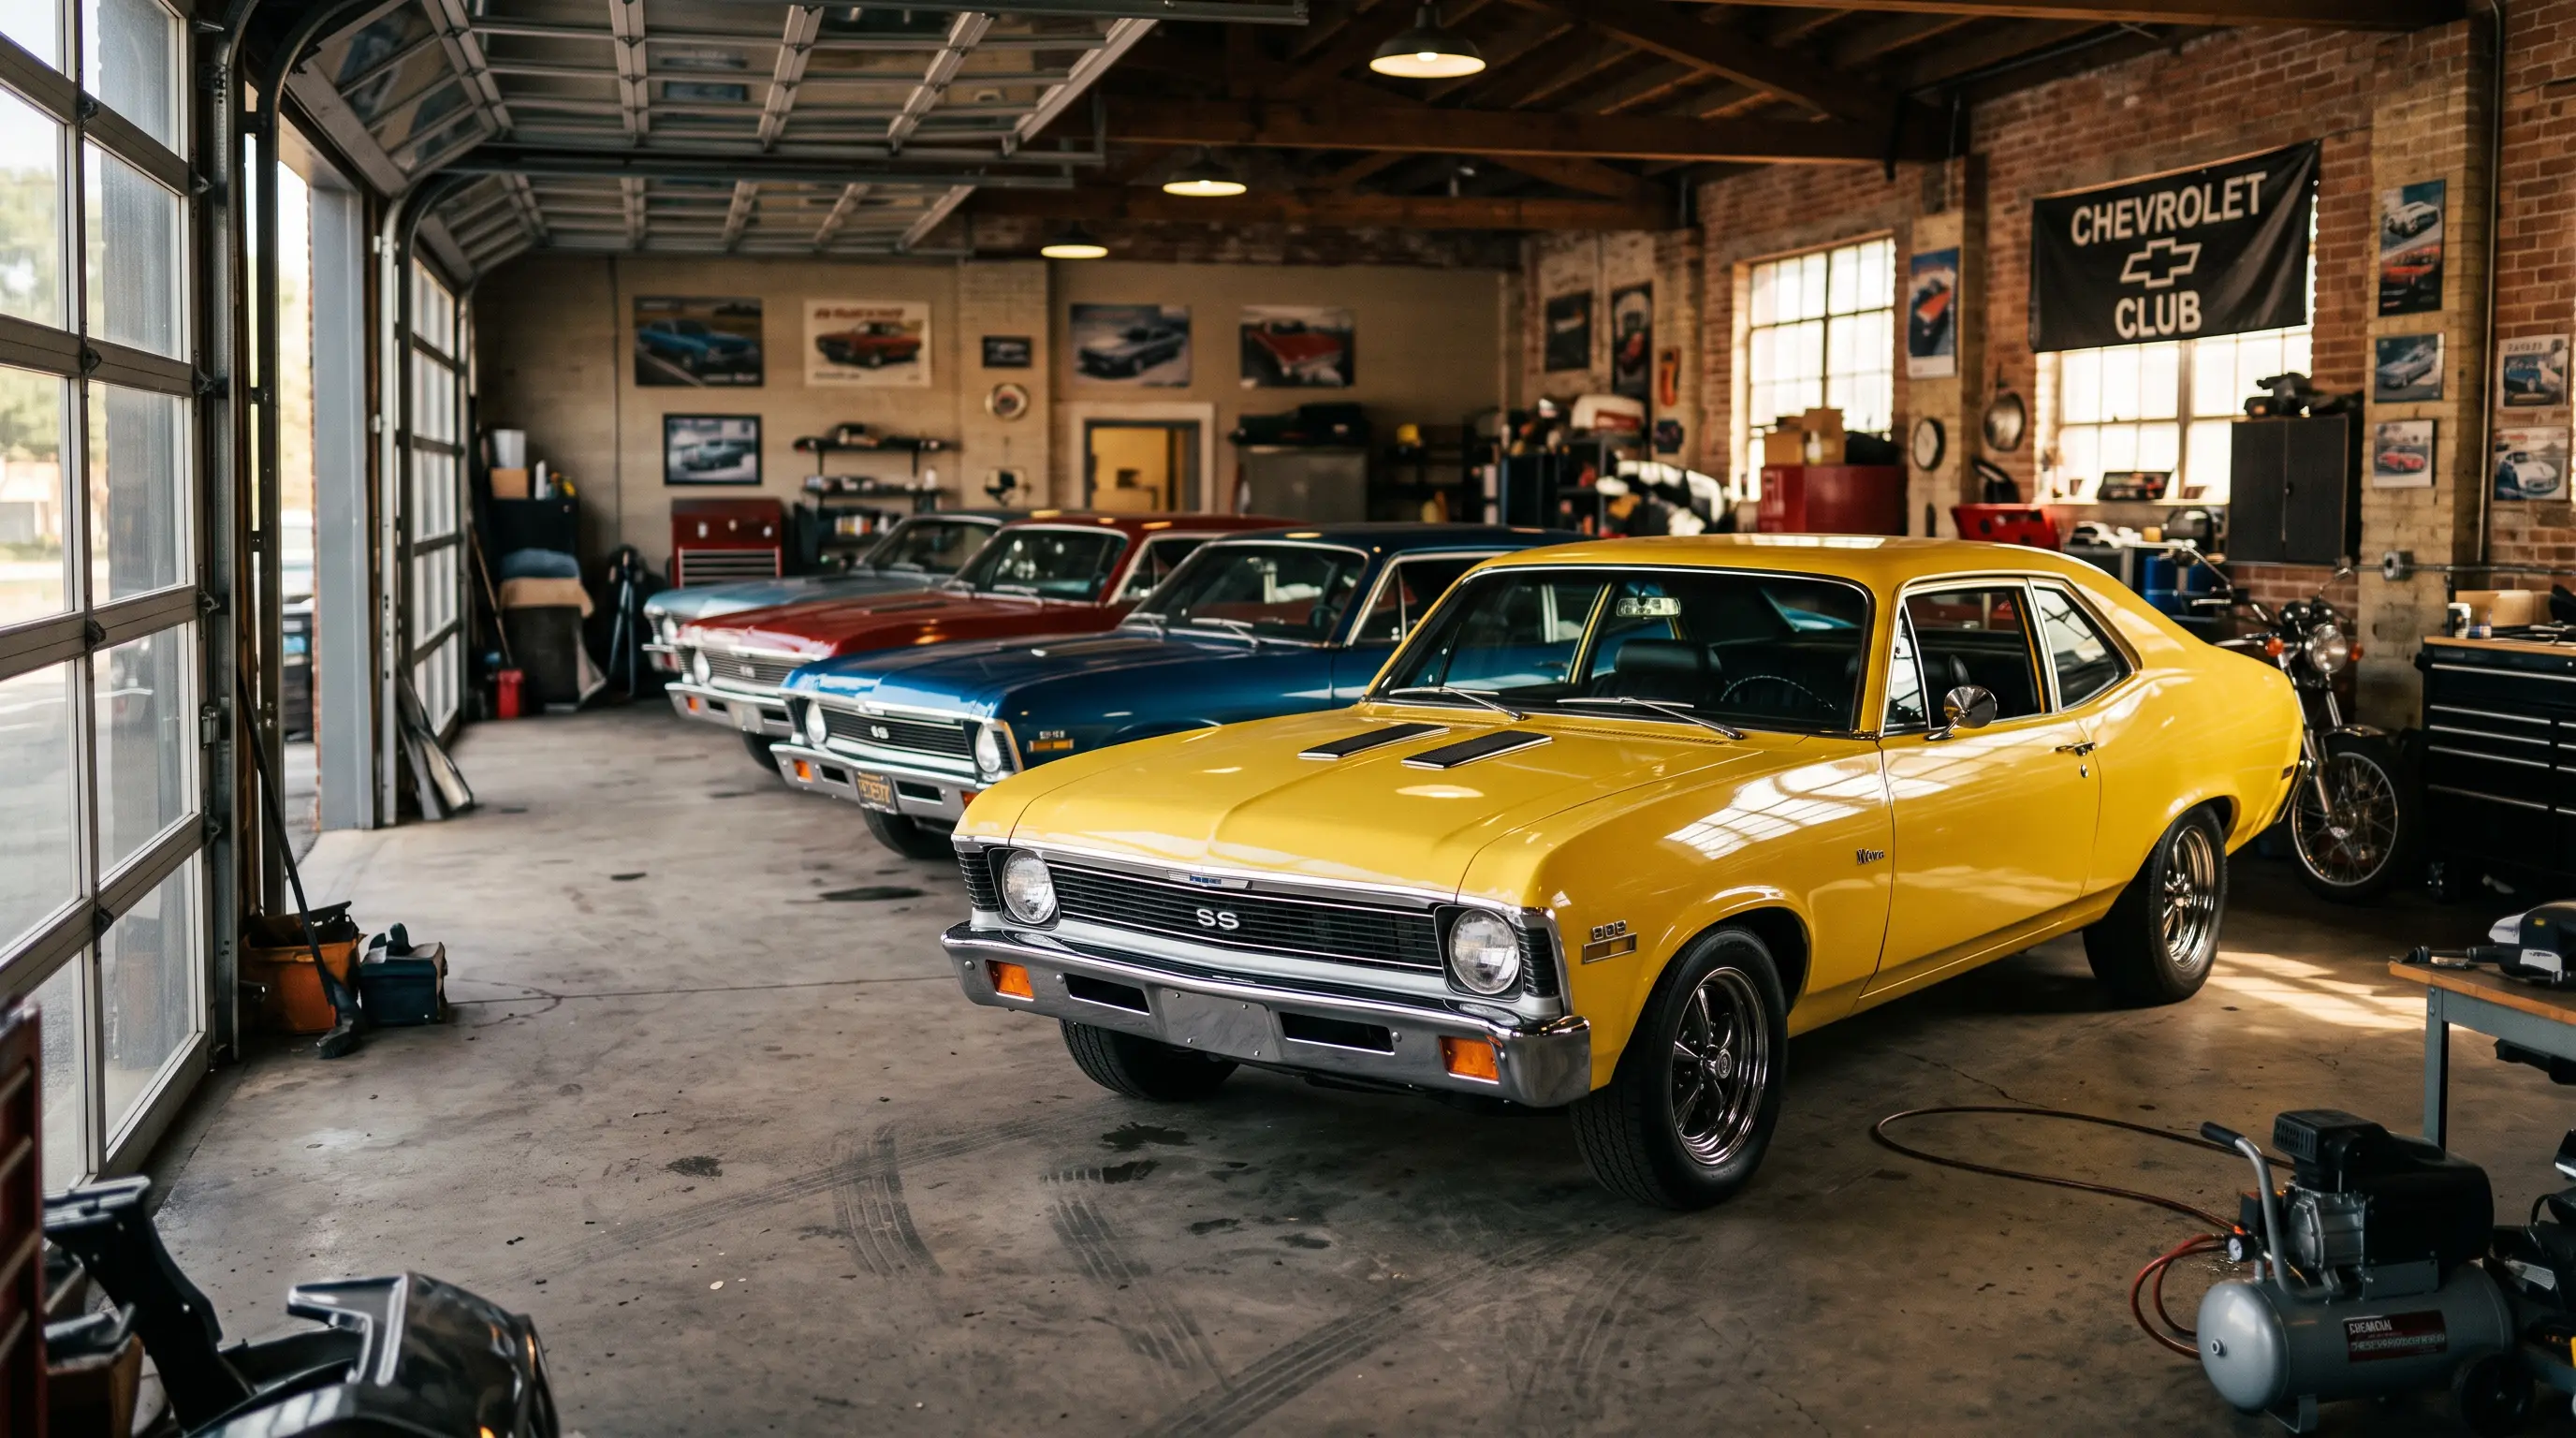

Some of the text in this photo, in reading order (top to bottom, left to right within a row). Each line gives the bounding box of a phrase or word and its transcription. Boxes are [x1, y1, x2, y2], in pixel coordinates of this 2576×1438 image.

[2071, 171, 2267, 246] CHEVROLET
[2115, 290, 2202, 339] CLUB
[1195, 907, 1240, 931] SS
